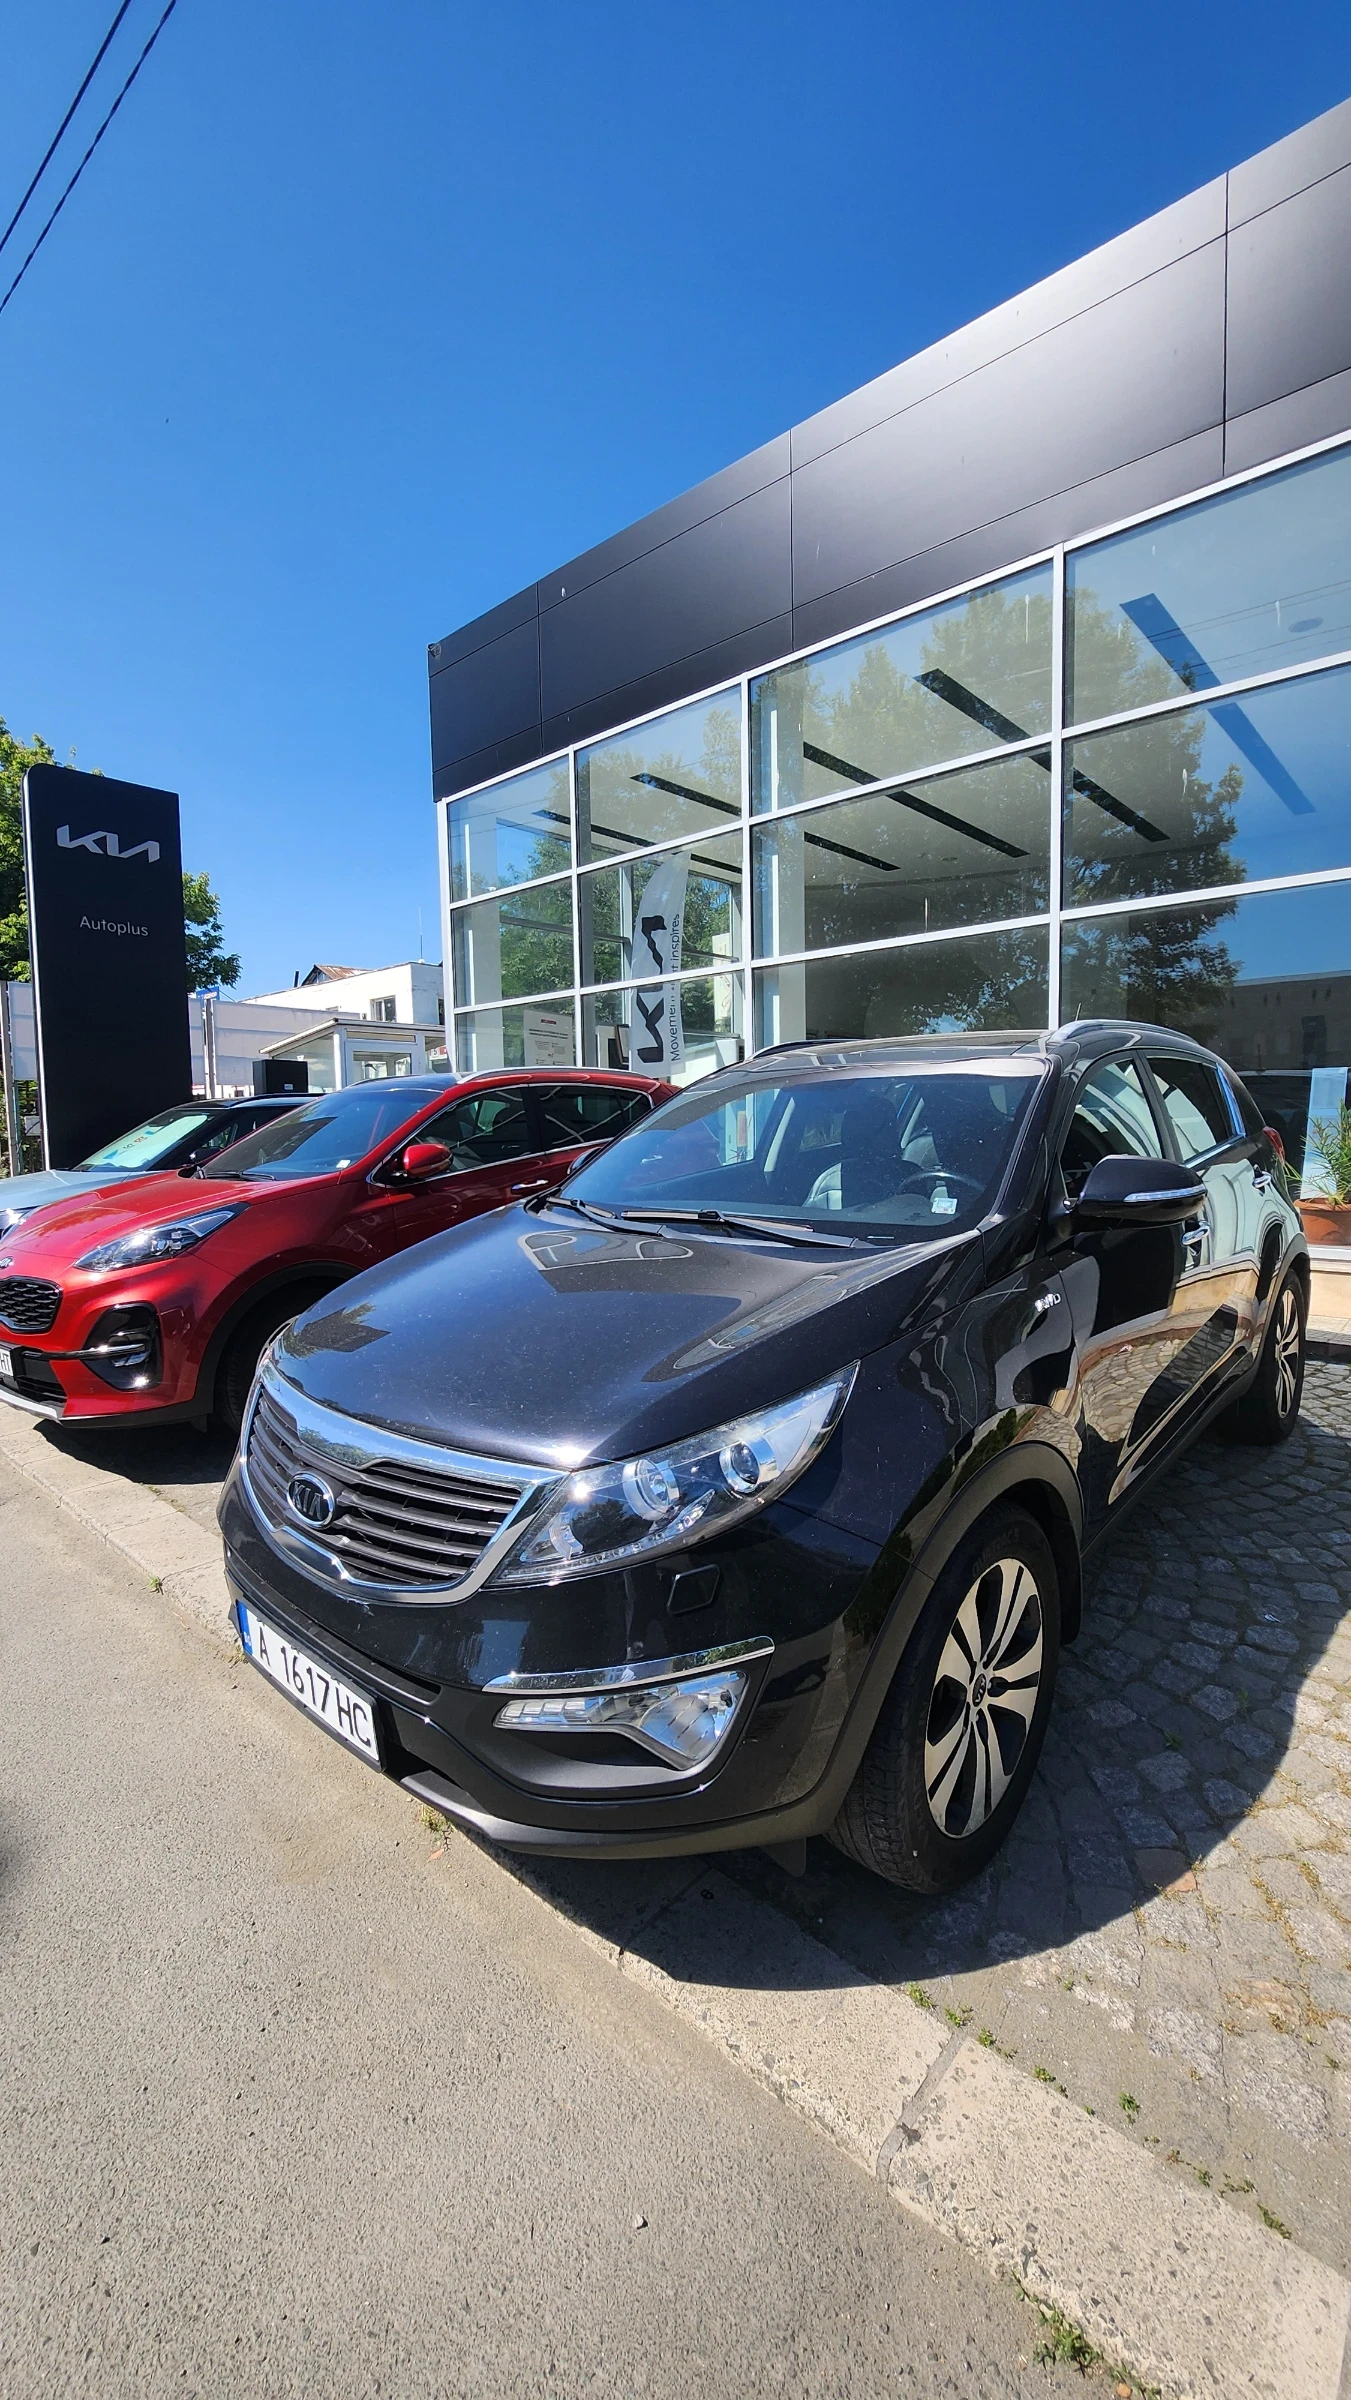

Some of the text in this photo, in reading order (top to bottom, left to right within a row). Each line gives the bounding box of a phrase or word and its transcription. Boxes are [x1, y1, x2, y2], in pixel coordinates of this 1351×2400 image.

[80, 915, 149, 937] Autoplus
[669, 913, 680, 961] inspires
[669, 994, 680, 1062] Moveme
[292, 1481, 323, 1521] KIA
[280, 1645, 330, 1714] 1617
[335, 1685, 372, 1748] HC
